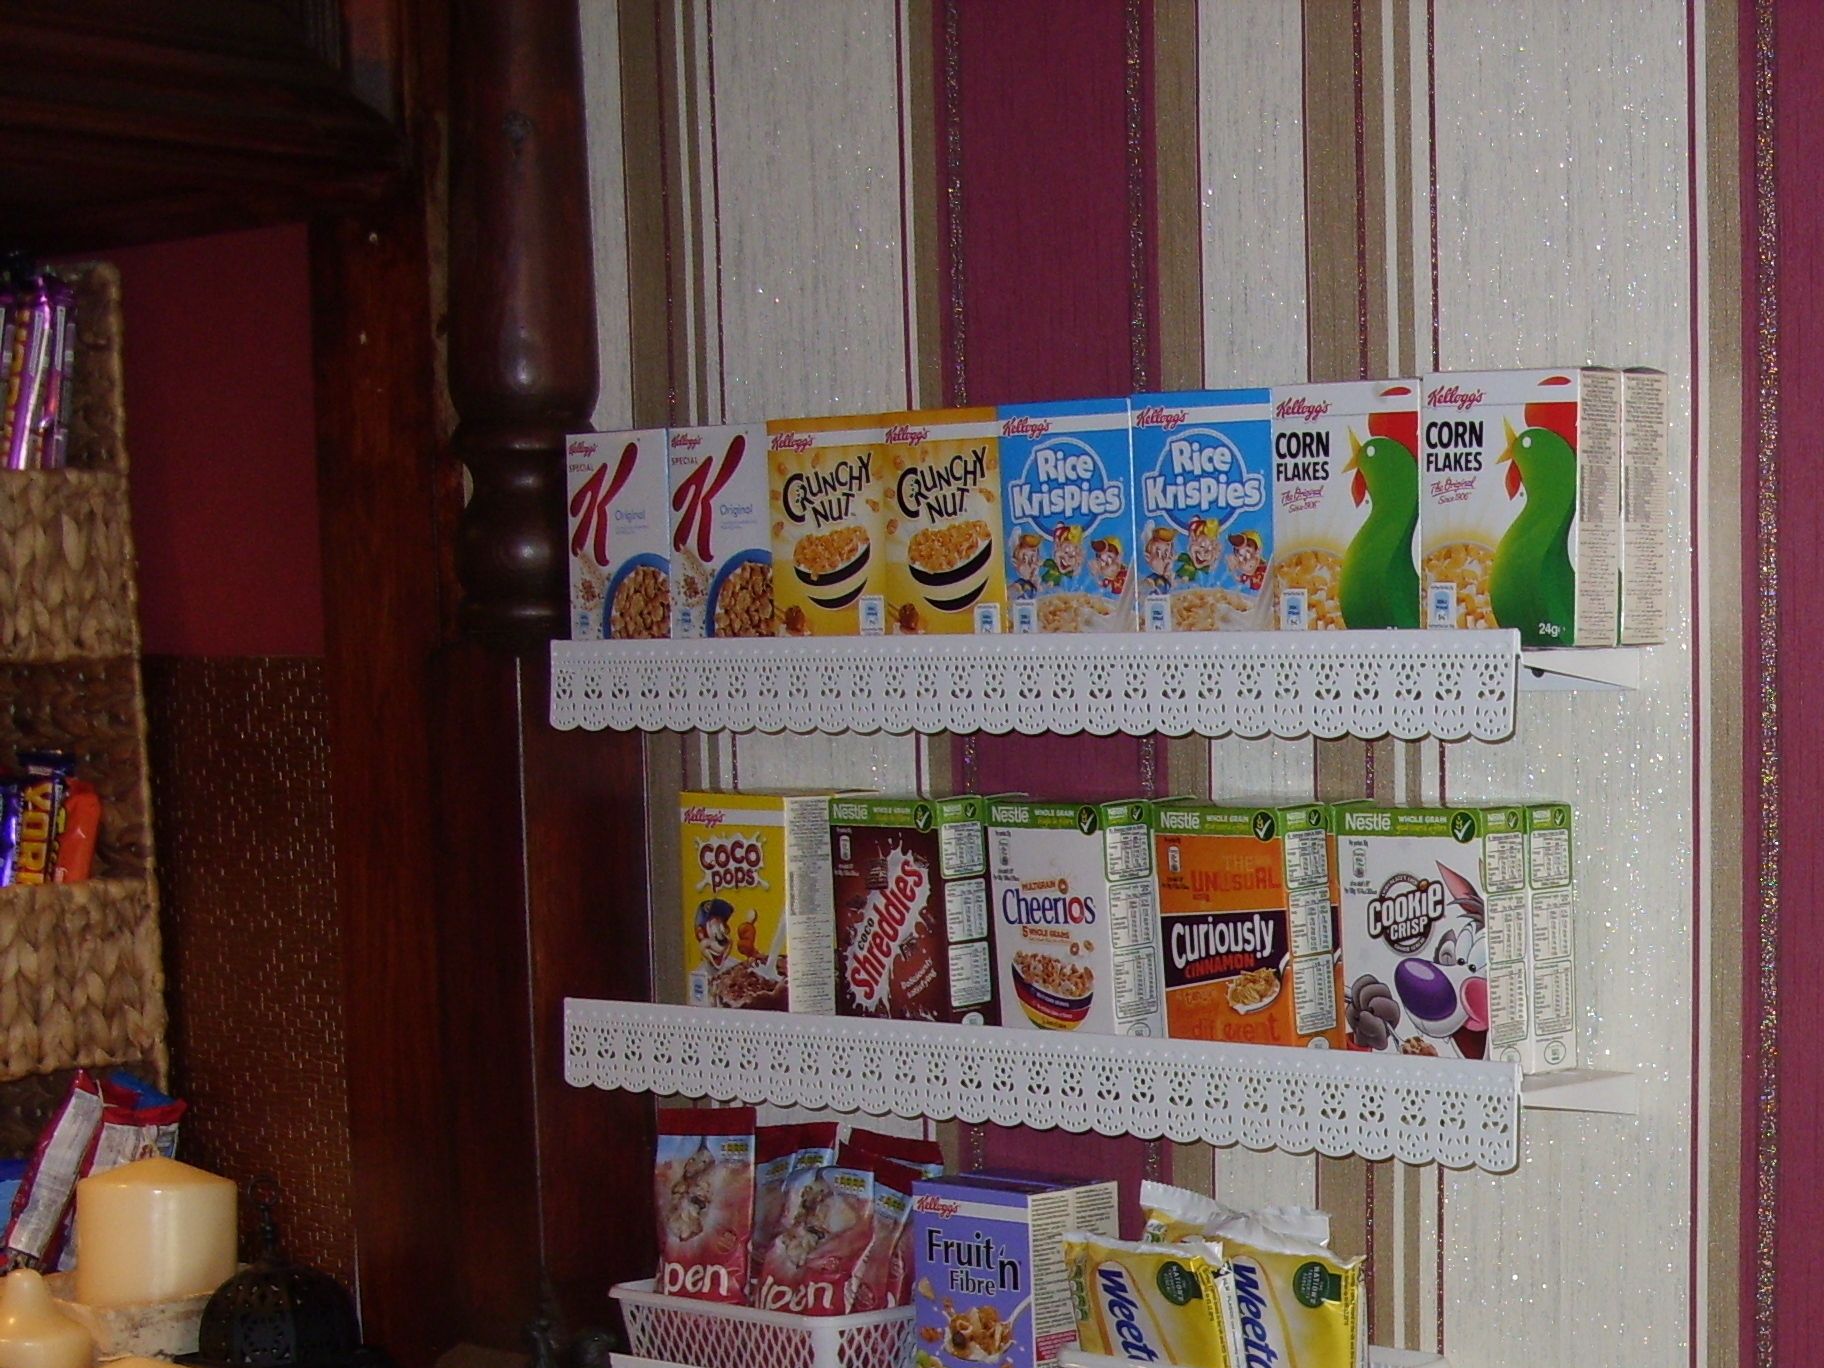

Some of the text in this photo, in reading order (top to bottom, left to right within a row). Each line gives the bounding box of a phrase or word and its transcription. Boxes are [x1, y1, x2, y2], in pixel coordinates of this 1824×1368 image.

[1276, 397, 1332, 421] Kellogg's
[1427, 385, 1485, 410] Kellogg's
[1002, 417, 1052, 439] Kellogg's
[1136, 407, 1189, 431] Kellogg's
[671, 433, 703, 449] Kellogg's
[771, 432, 816, 452] Kellogg's
[885, 425, 931, 446] Kellogg's
[1275, 431, 1330, 459] CORN
[1426, 420, 1484, 449] CORN
[569, 441, 598, 457] Kellogg's
[1170, 440, 1232, 475] Rice
[1036, 449, 1094, 483] Rice
[1276, 461, 1330, 482] FLAKES
[1426, 452, 1482, 473] FLAKES
[782, 452, 872, 523] CRUNCHY
[897, 446, 988, 519] CRUNCHY
[1146, 474, 1262, 512] Krispies
[570, 442, 638, 566] K
[672, 434, 746, 563] K
[720, 504, 753, 517] Original
[811, 492, 855, 528] NUT
[926, 487, 969, 524] NUT
[1012, 481, 1121, 519] Krispies
[615, 510, 646, 522] Original
[684, 806, 725, 828] Kellogg's
[1056, 809, 1074, 817] GRAIN
[1206, 815, 1249, 823] WHOLE GRAIN
[1397, 815, 1447, 824] WHOLE GRAIN
[700, 840, 762, 870] COCO
[711, 866, 755, 893] pops
[1002, 888, 1096, 925] Cheerios
[1172, 914, 1274, 969] Curiously
[1391, 917, 1428, 940] CRISP
[1185, 953, 1254, 978] CINNAMON
[917, 1197, 960, 1218] Kellogg's
[928, 1228, 994, 1269] Fruit
[664, 1262, 729, 1296] pen
[950, 1270, 995, 1295] Fibre
[760, 1275, 833, 1311] lpen
[1098, 1268, 1159, 1362] Weet
